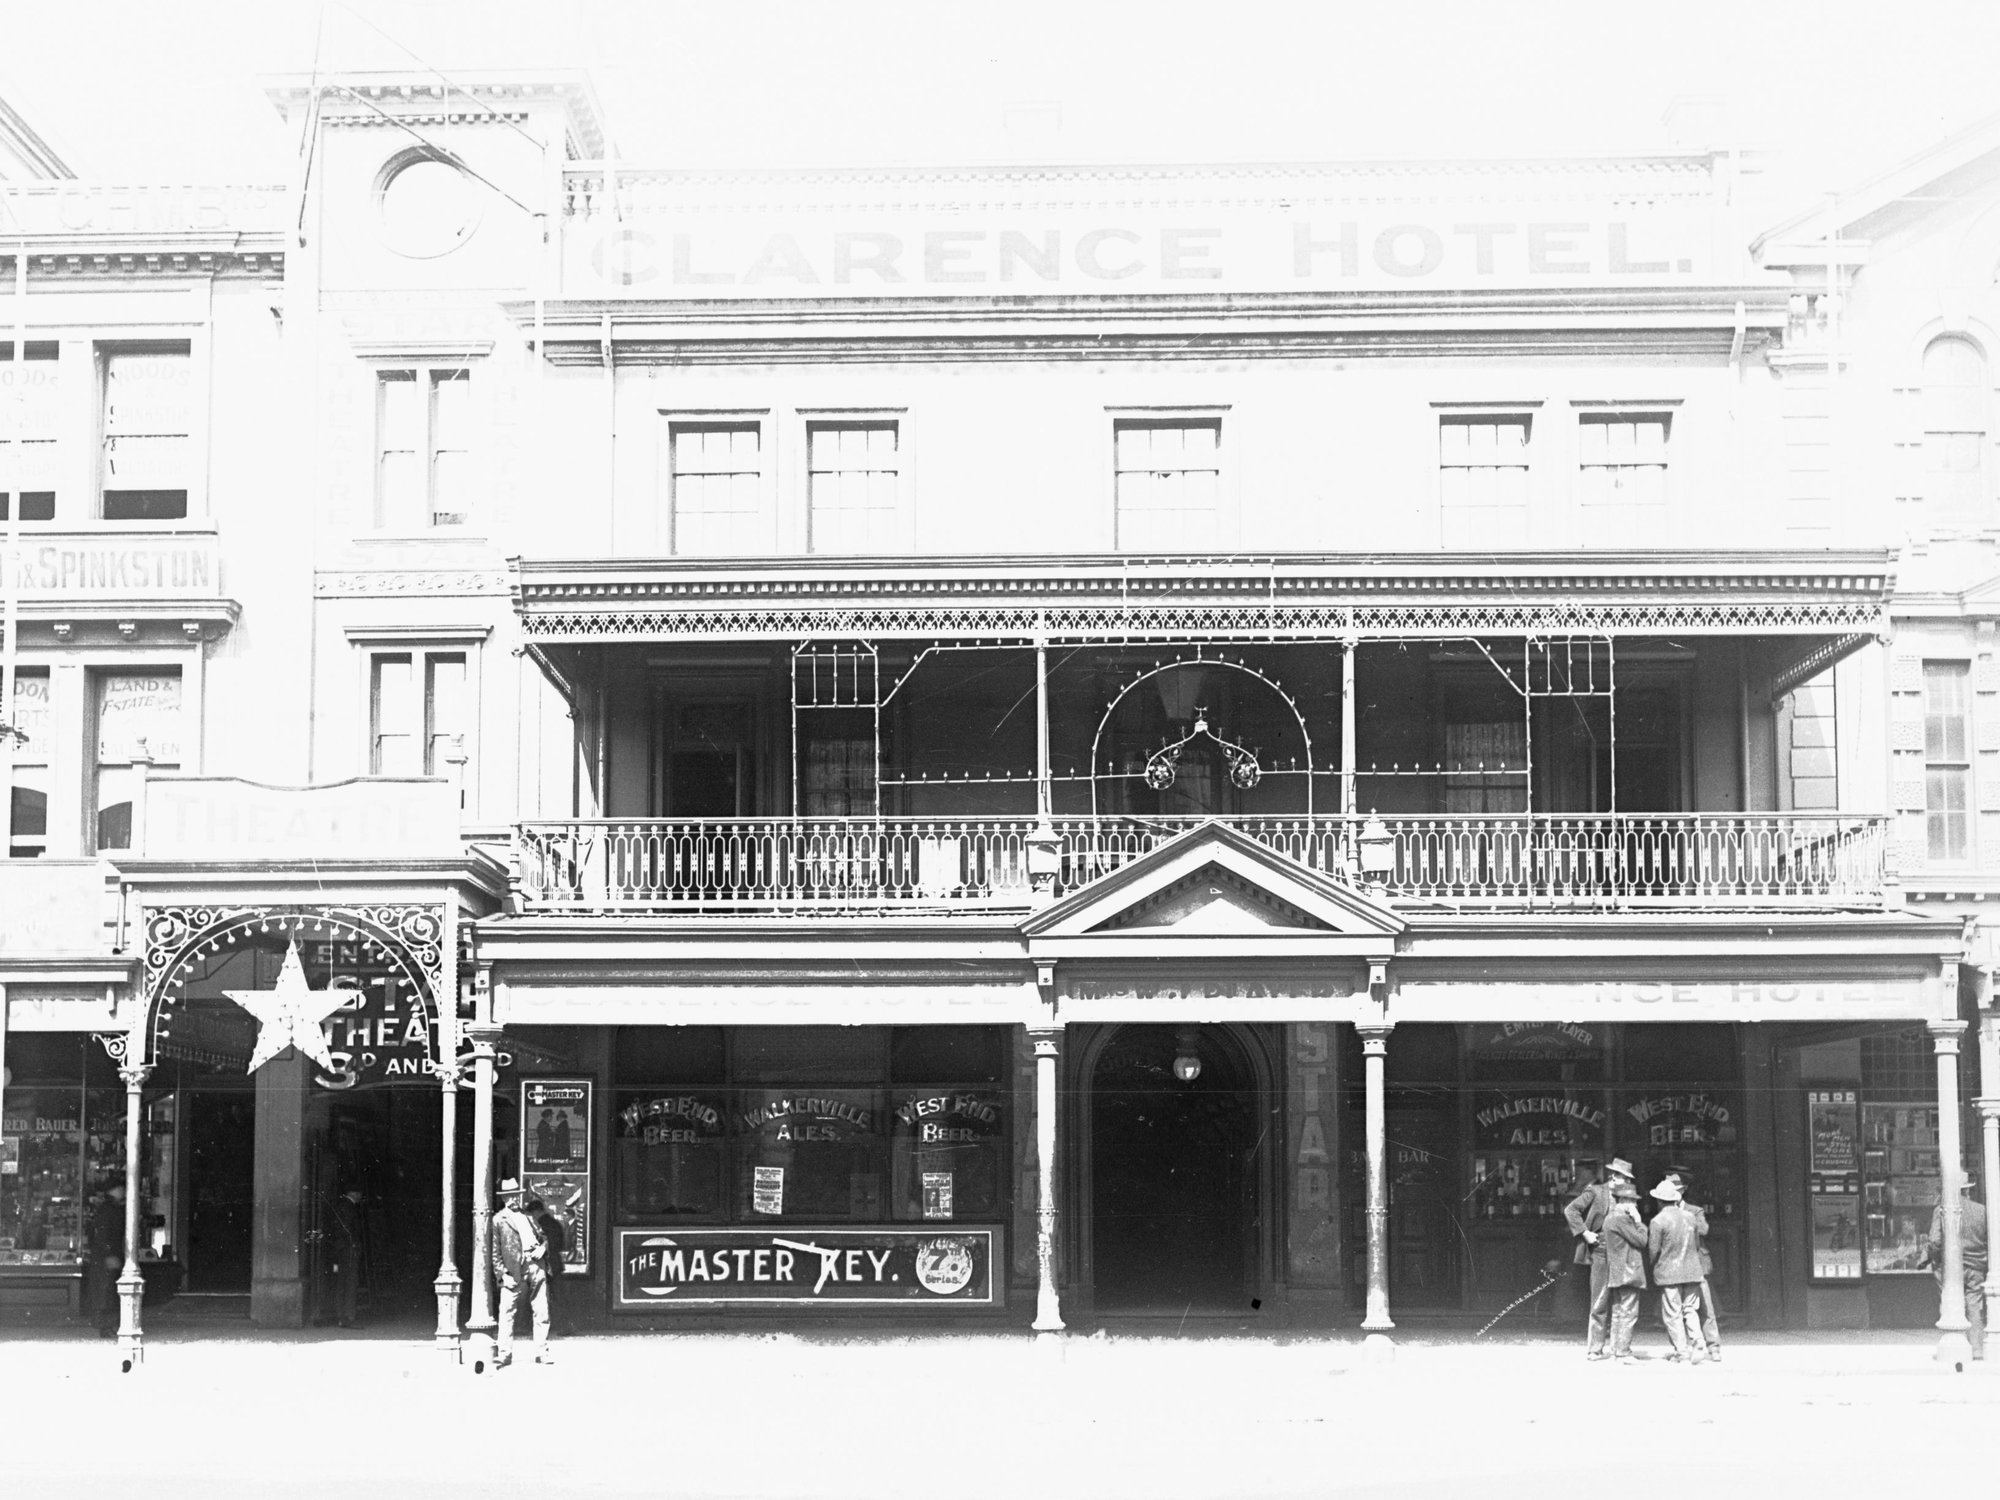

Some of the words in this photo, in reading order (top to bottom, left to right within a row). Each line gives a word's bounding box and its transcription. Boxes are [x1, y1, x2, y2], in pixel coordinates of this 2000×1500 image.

[591, 227, 1222, 286] CLARENCE
[1292, 221, 1693, 279] HOTEL.
[39, 546, 208, 589] SPINKSTON
[110, 679, 159, 693] LAND
[164, 791, 431, 843] THEATRE
[385, 1057, 439, 1075] AND
[36, 1117, 77, 1131] BAUER
[744, 1097, 872, 1129] WALKERVILLE
[897, 1096, 949, 1127] WEST
[1476, 1096, 1606, 1129] WALKERVILLE
[1398, 1150, 1430, 1164] BAR
[629, 1252, 657, 1277] THE
[659, 1249, 795, 1282] MASTER
